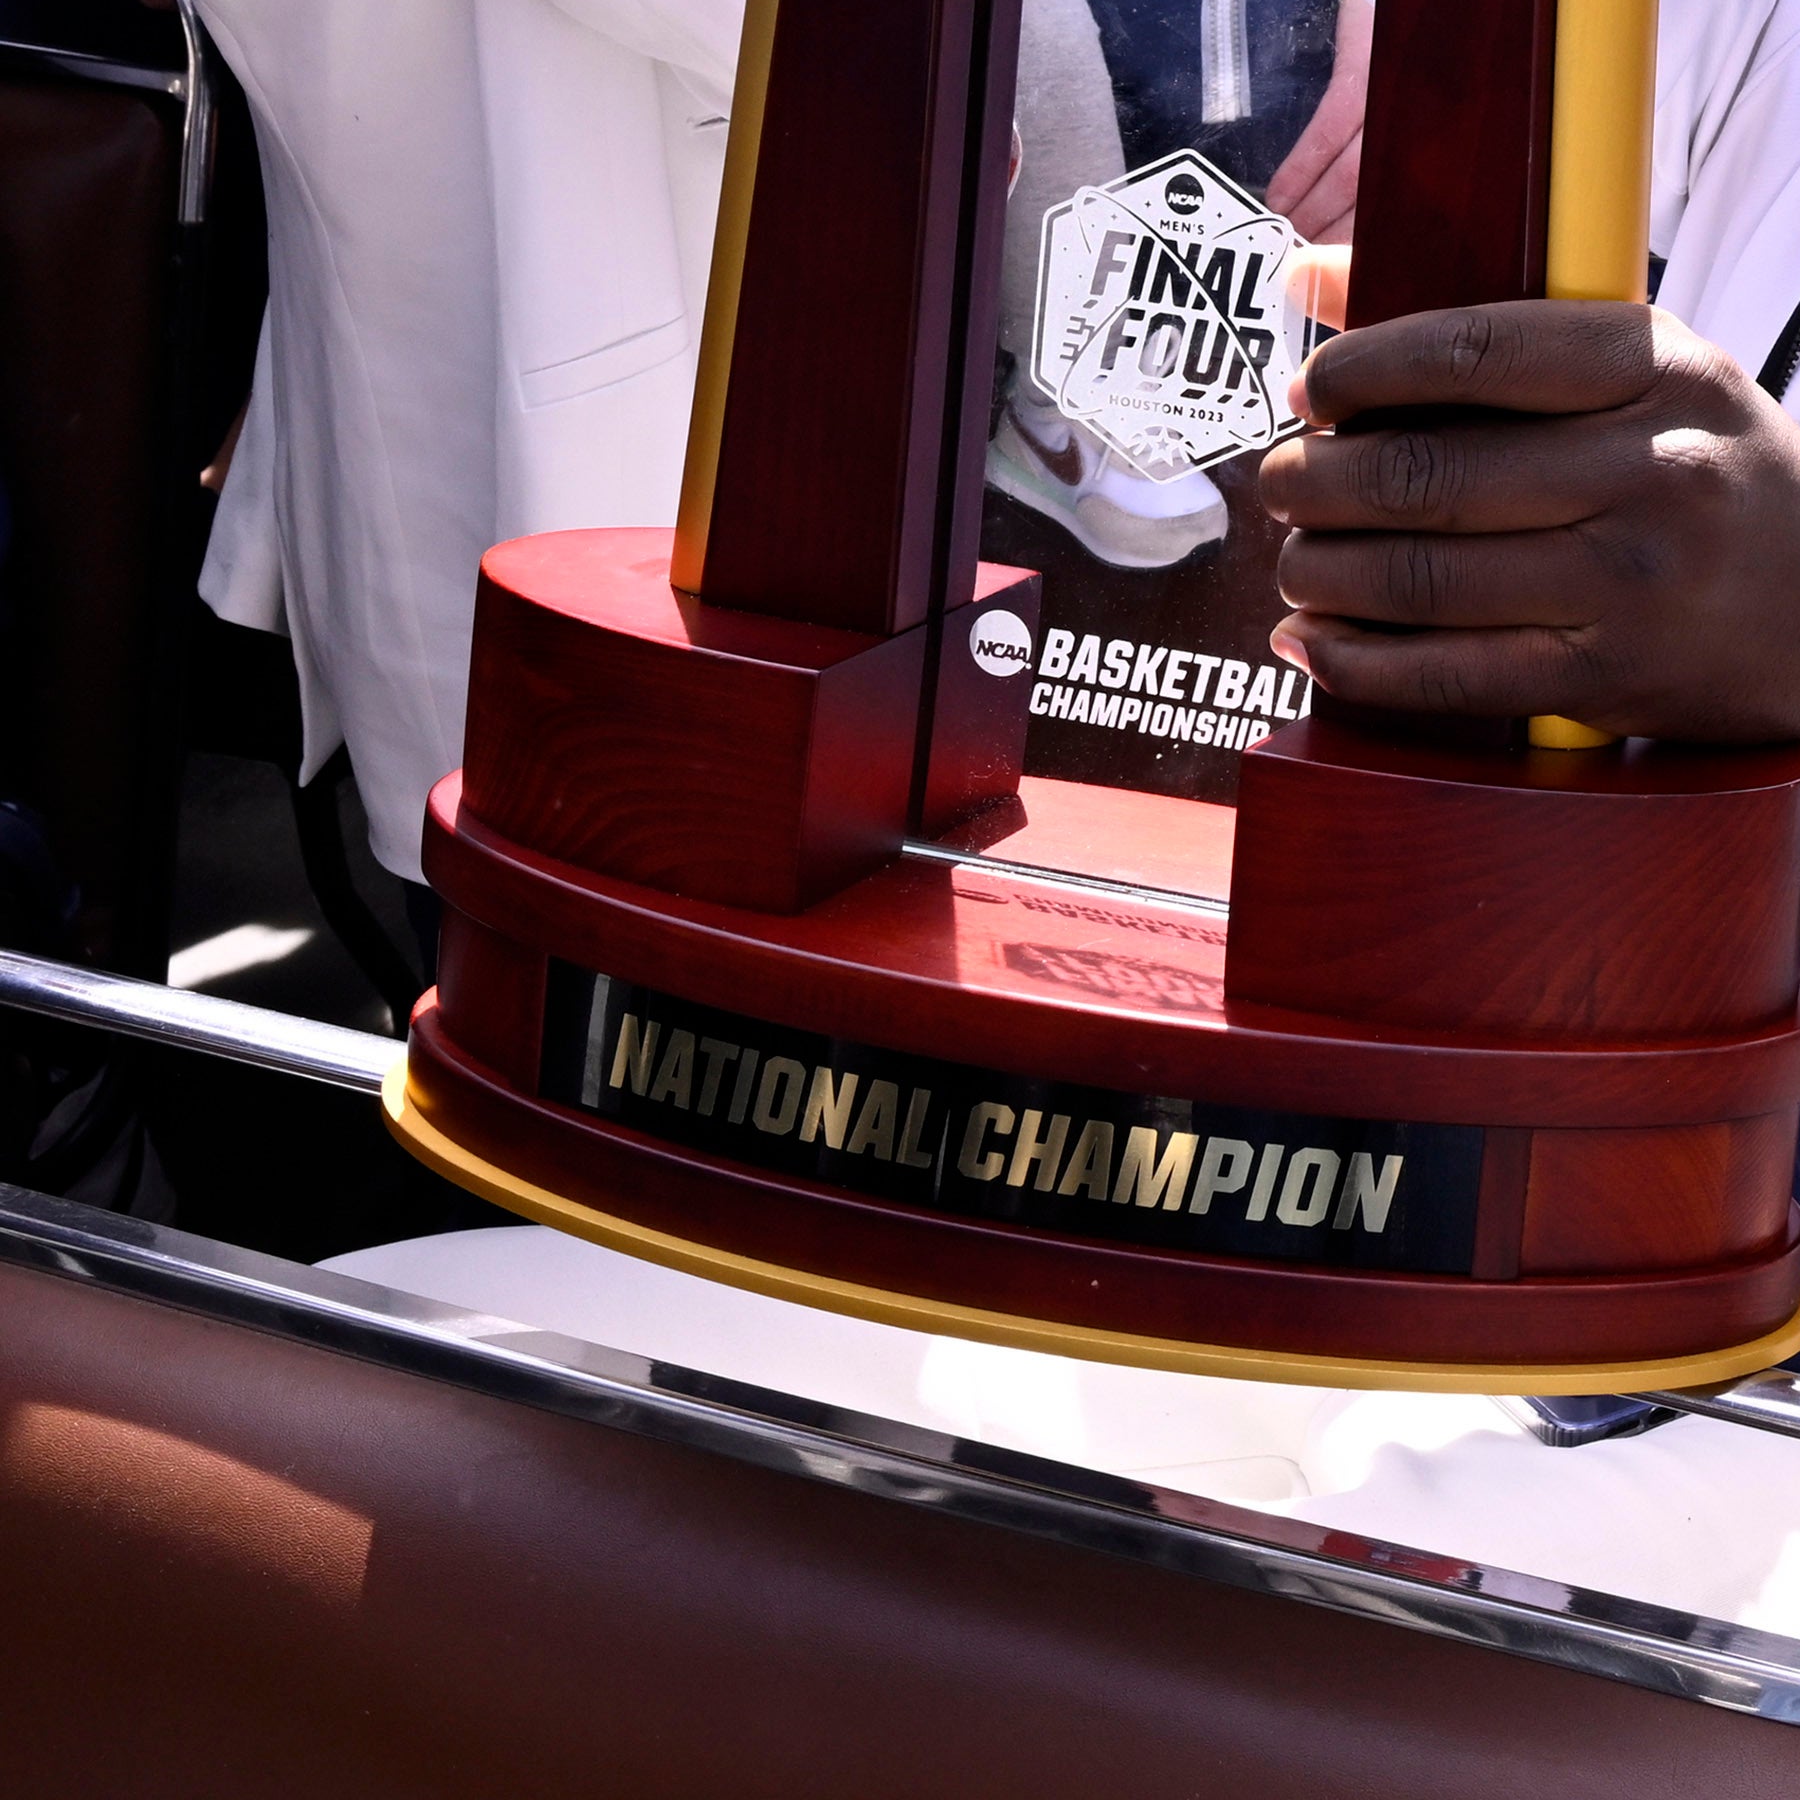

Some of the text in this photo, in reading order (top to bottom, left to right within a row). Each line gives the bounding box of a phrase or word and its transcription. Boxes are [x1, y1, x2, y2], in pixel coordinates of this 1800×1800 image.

[1167, 191, 1204, 207] NCAA
[1159, 218, 1206, 235] MEN'S
[1089, 229, 1265, 320] FINAL
[1100, 306, 1276, 394] FOUR
[1108, 393, 1225, 424] HOUSTON 2023
[975, 639, 1030, 663] NCAA
[608, 1012, 1403, 1235] NATIONAL CHAMPION
